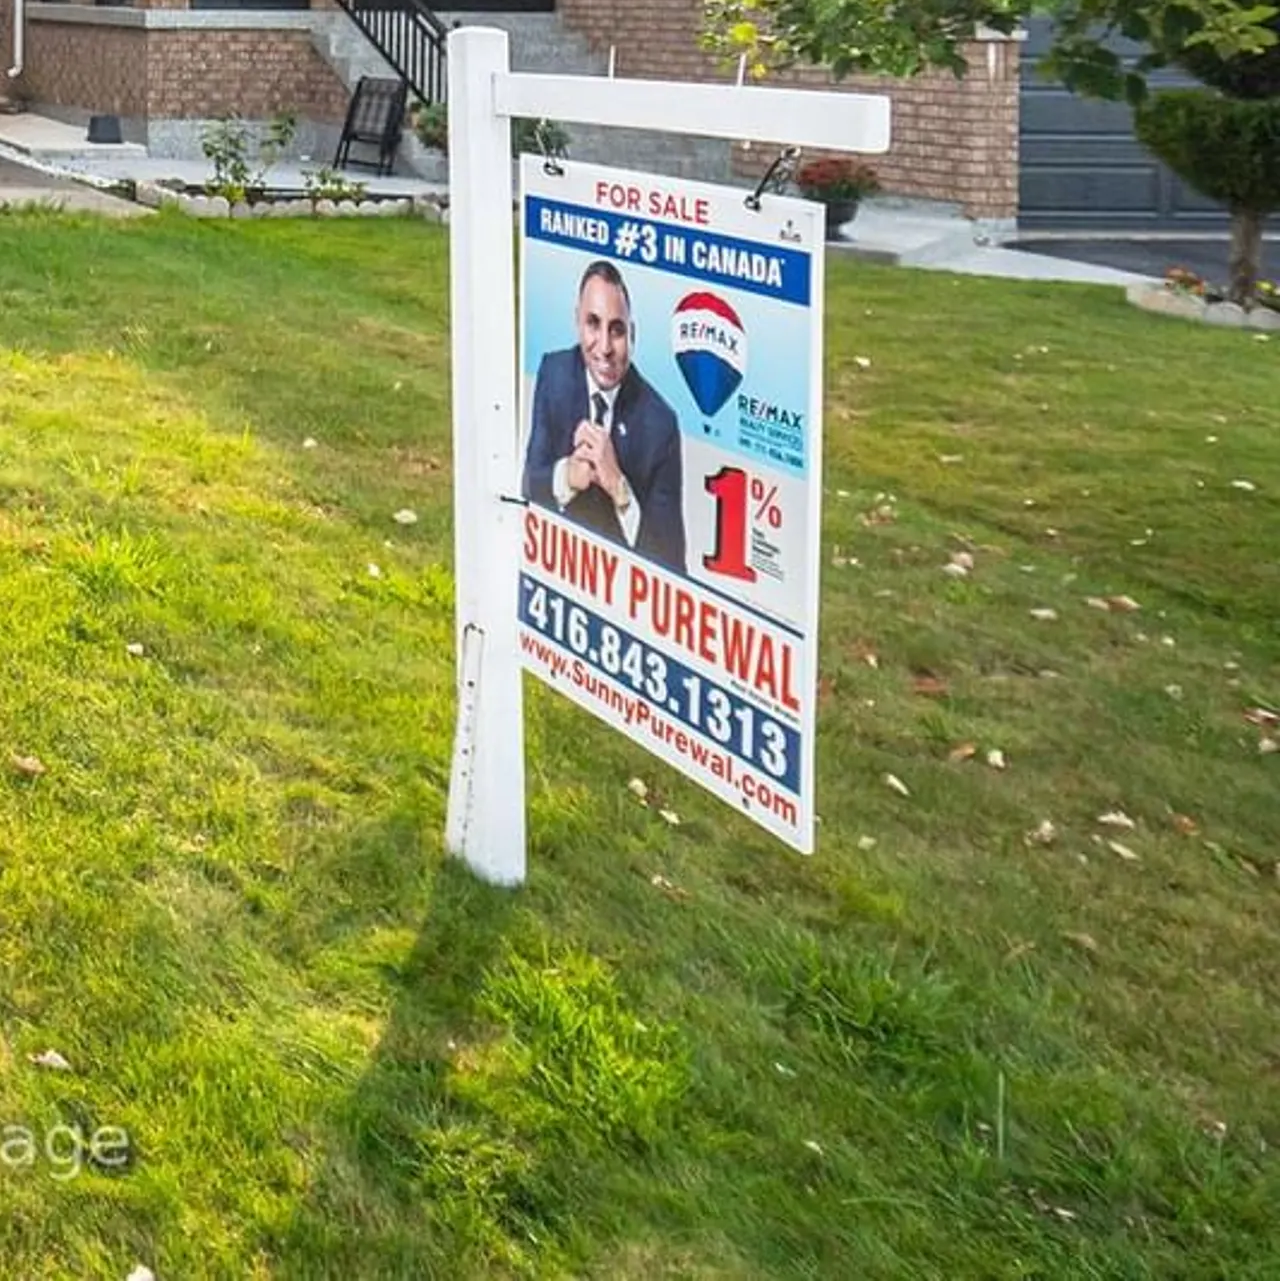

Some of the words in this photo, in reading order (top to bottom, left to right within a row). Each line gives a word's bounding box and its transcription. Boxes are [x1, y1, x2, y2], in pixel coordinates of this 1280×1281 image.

[540, 207, 610, 248] RANKED
[614, 220, 658, 263] #3
[665, 235, 686, 265] IN
[595, 181, 641, 211] FOR
[648, 192, 710, 225] SALE
[680, 323, 740, 355] RE/MAX
[737, 394, 803, 430] RE/MAX
[702, 465, 782, 584] 1%
[522, 511, 621, 607] SUNNY
[629, 569, 801, 713] PUREWAL
[527, 587, 788, 779] 416.843.1313
[520, 632, 798, 828] www.SunnyPurewal.com
